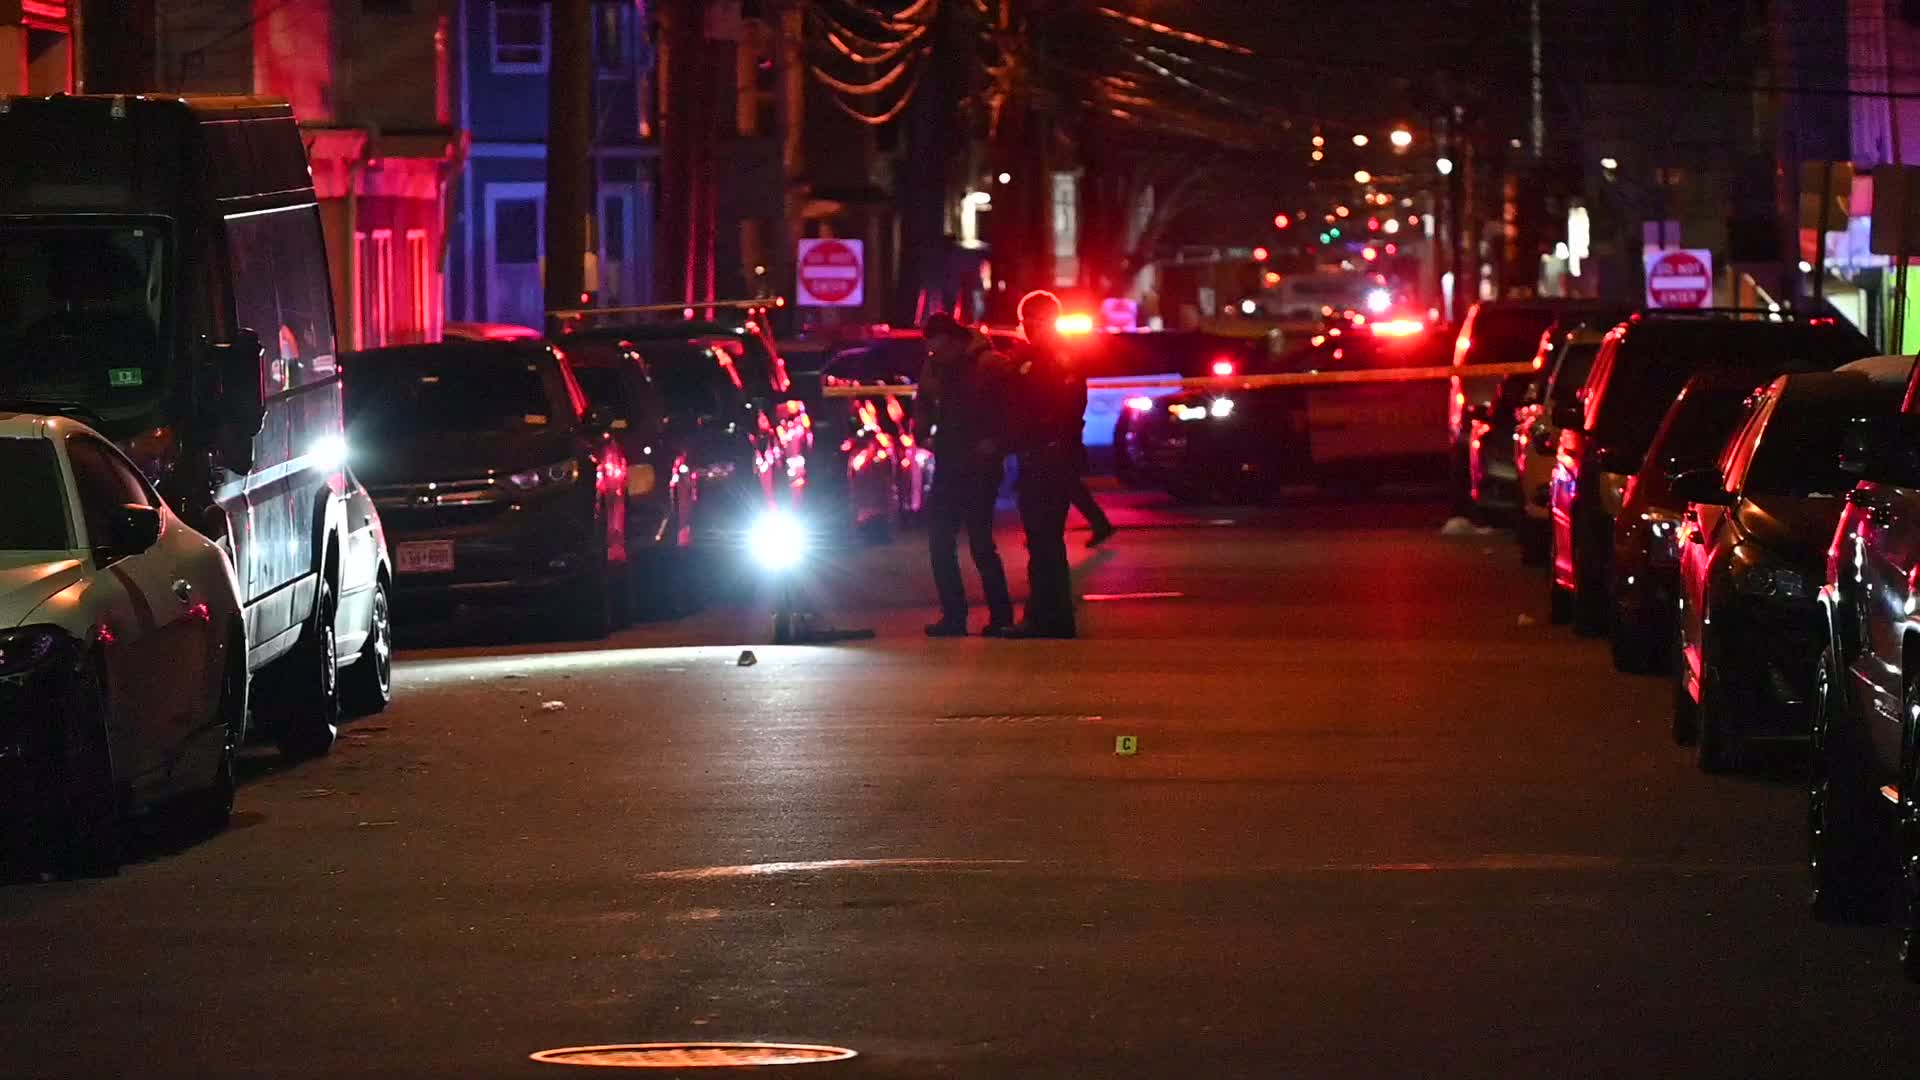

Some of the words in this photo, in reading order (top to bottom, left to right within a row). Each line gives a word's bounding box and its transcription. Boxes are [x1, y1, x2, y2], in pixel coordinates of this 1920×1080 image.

[1677, 263, 1700, 274] NOT
[1661, 291, 1697, 303] ENTER
[1123, 737, 1131, 751] C
